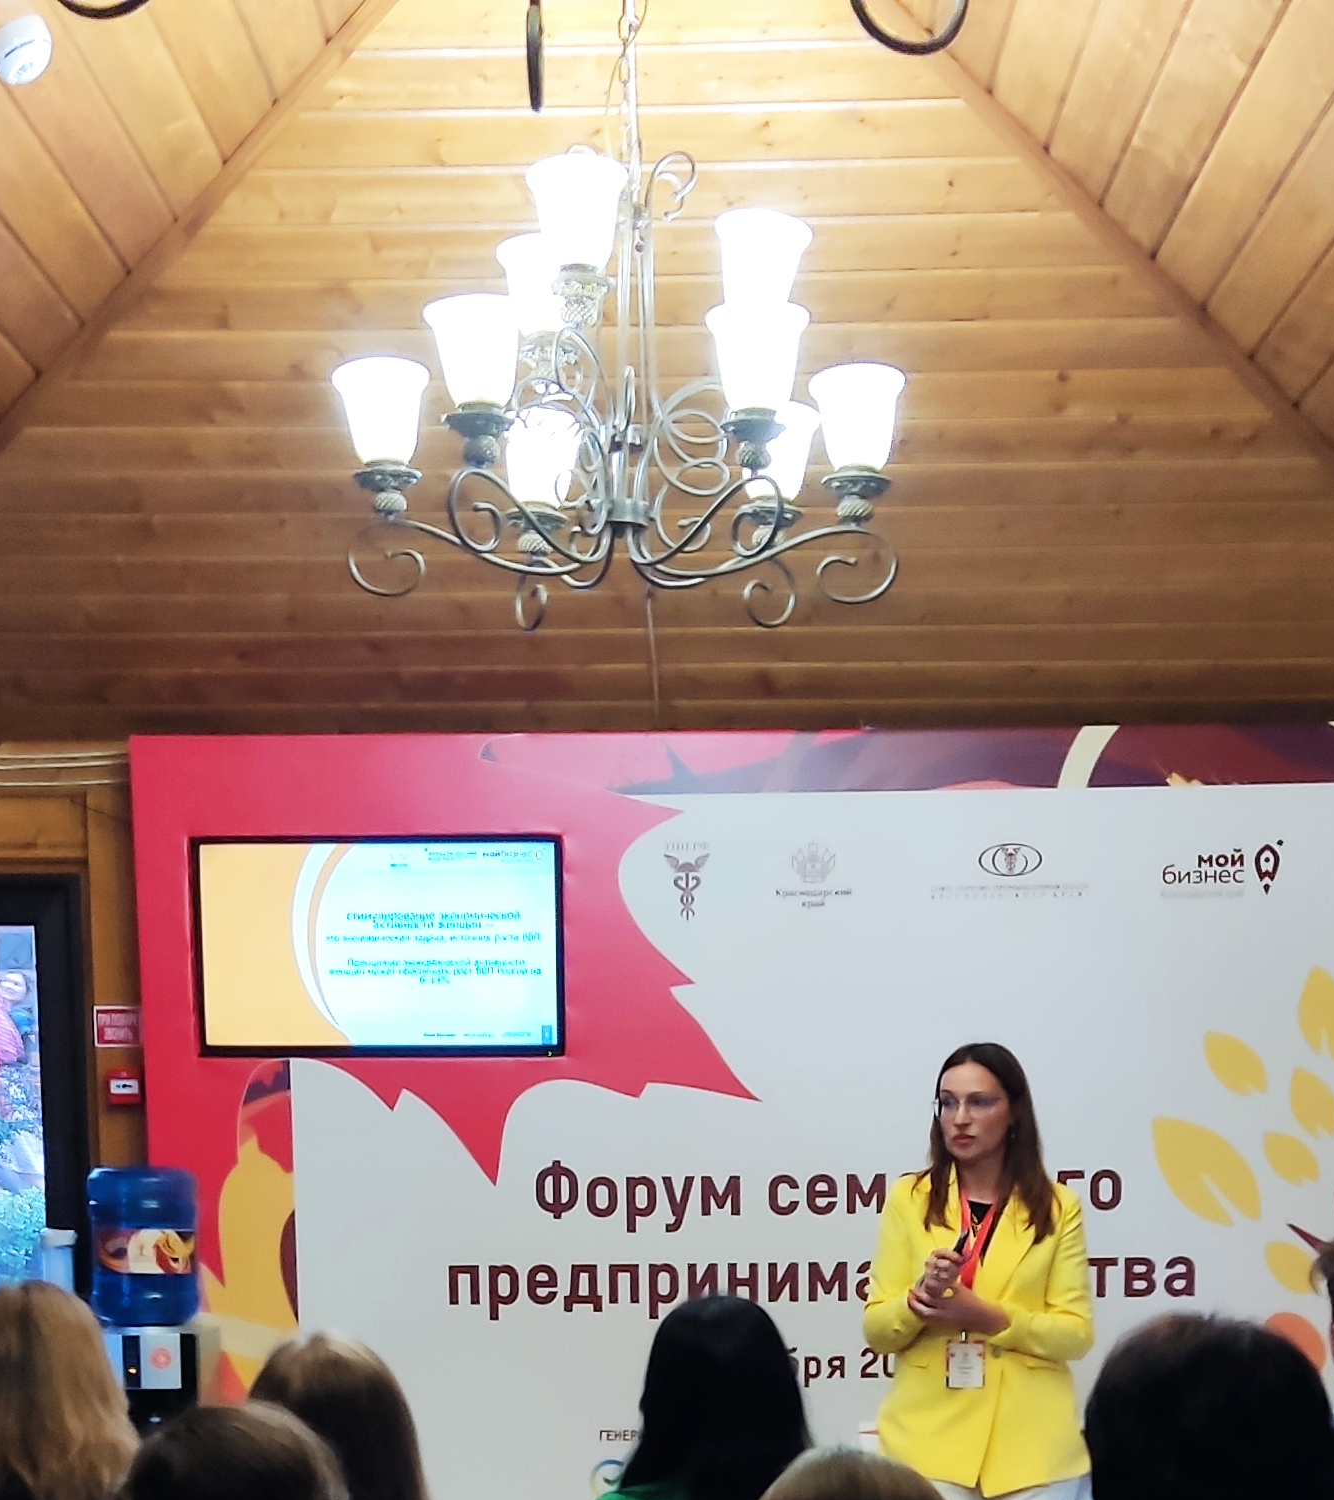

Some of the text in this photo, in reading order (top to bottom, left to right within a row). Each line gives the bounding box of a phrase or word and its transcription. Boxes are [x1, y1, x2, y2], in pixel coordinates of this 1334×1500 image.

[1197, 847, 1245, 868] мой
[1161, 863, 1245, 885] бизнес
[535, 1160, 742, 1233] Форум
